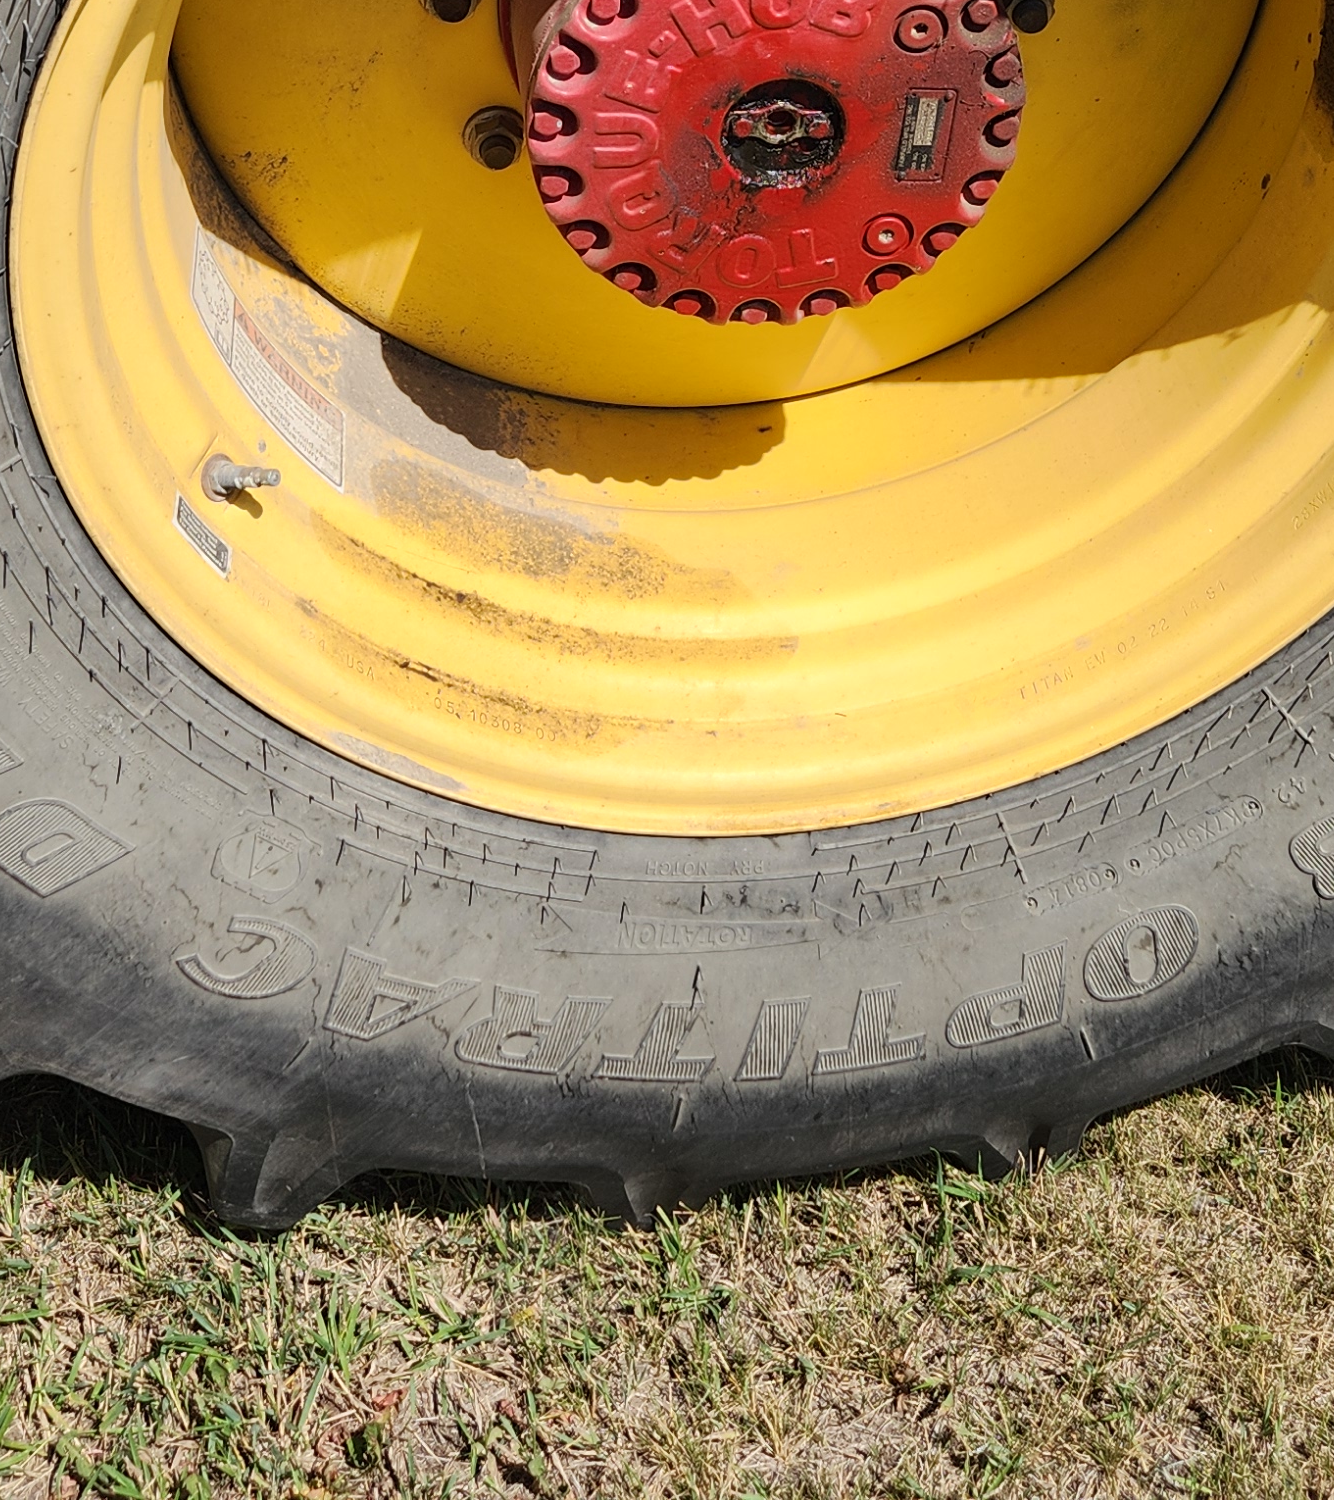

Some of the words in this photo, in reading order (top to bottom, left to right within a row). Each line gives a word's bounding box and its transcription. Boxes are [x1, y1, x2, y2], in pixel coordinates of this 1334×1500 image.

[343, 654, 377, 681] USA
[1016, 664, 1075, 701] TITAN
[14, 691, 75, 751] SAFETY
[642, 859, 709, 876] NOTCH
[729, 857, 765, 875] PRY
[614, 921, 752, 947] ROTATION
[176, 904, 1199, 1082] OPTITRAC
